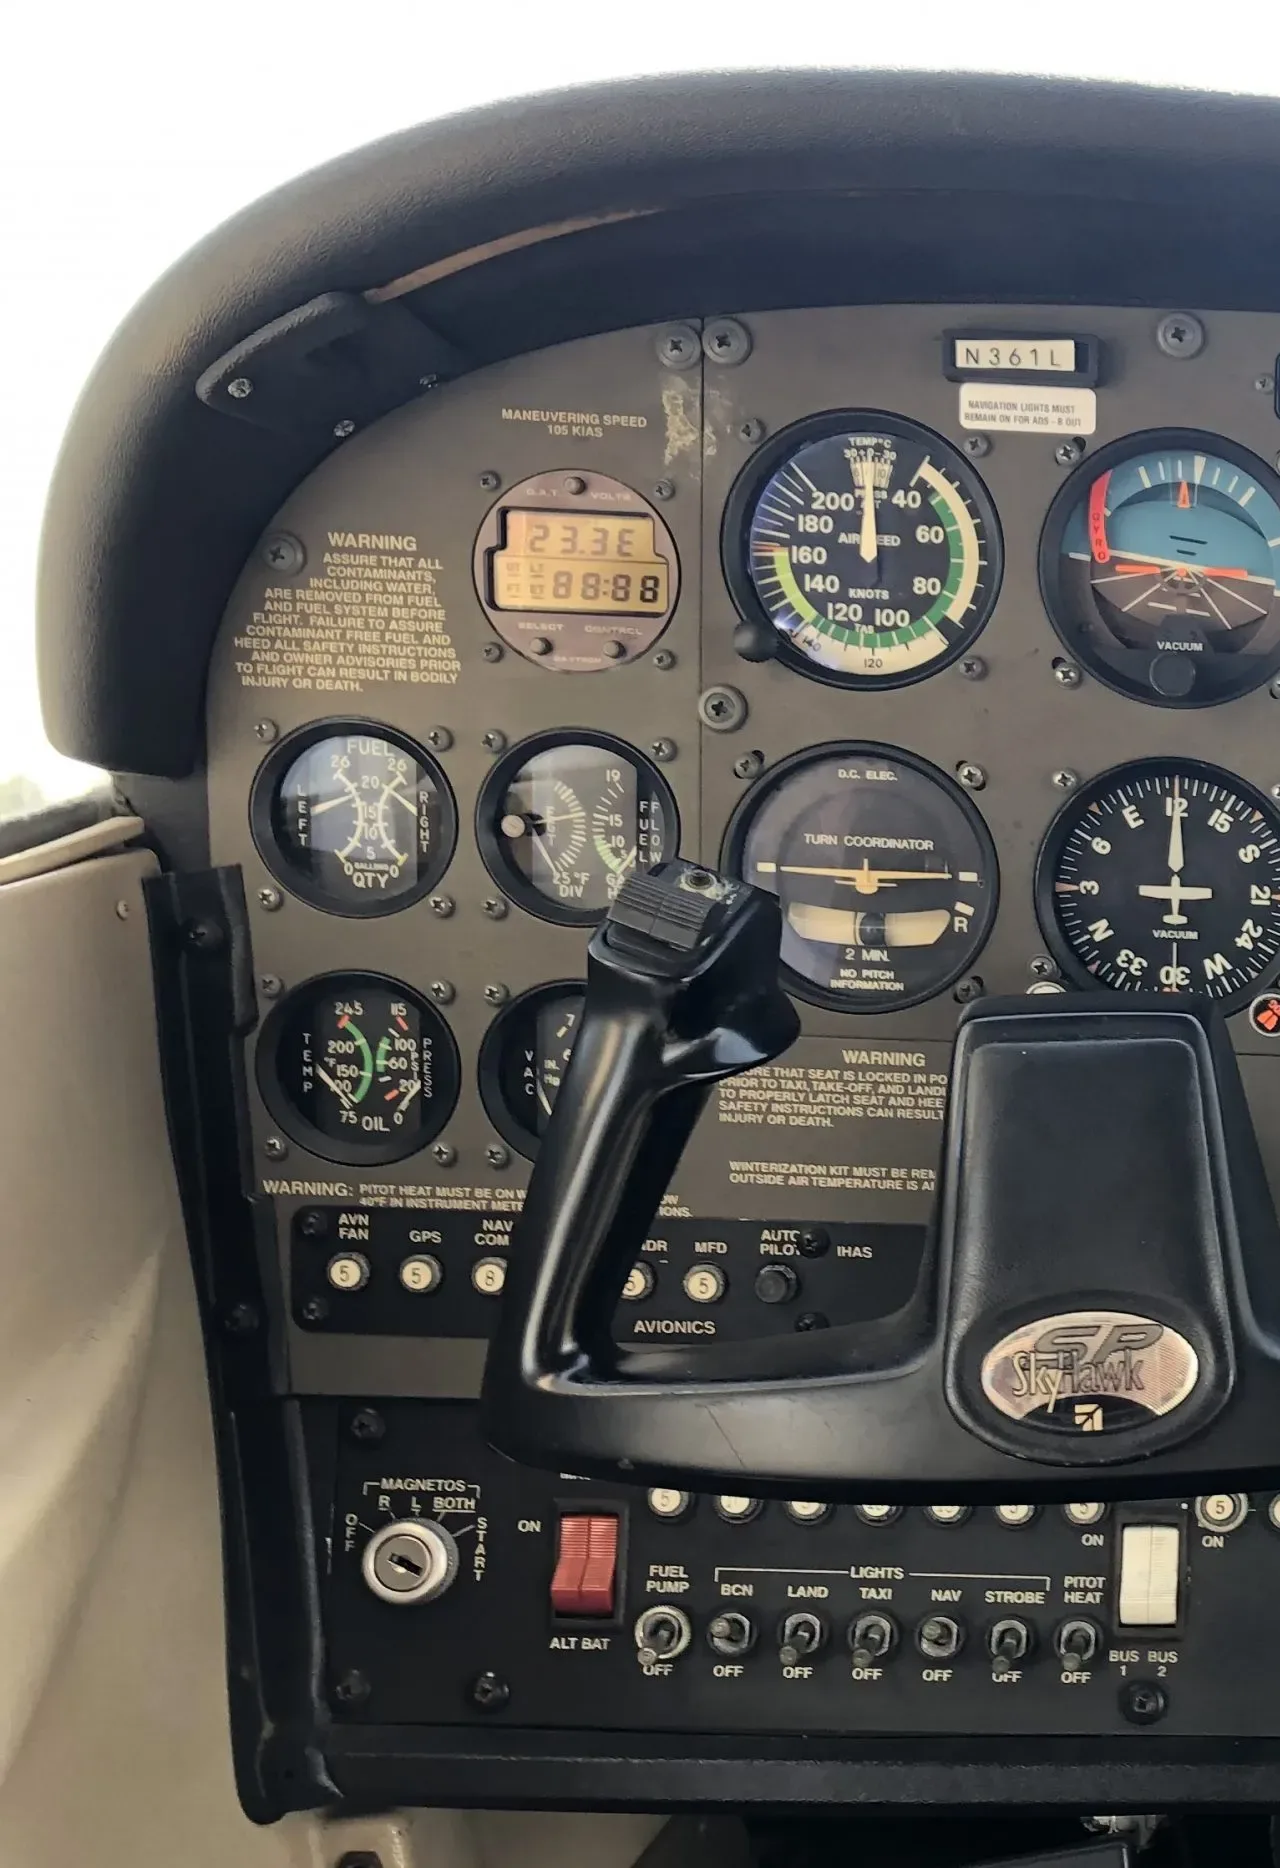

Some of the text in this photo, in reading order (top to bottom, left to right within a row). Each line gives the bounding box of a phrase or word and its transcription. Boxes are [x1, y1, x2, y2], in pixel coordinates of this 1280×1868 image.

[1020, 402, 1049, 414] LIGHTS
[1051, 404, 1075, 415] MUST
[501, 408, 647, 428] MANEUVERING SPEED
[547, 425, 604, 438] 105 KIAS
[811, 492, 854, 511] 200
[891, 490, 921, 509] 40
[798, 514, 833, 534] 180
[327, 531, 417, 552] WARNING
[915, 526, 944, 544] 60
[323, 552, 444, 570] ASSURE THAT ALL
[791, 546, 827, 565] 160
[309, 577, 384, 593] INCLUDING
[913, 577, 941, 596] 80
[848, 589, 889, 600] KNOTS
[1156, 641, 1203, 652] VACUUM
[346, 739, 395, 758] FUEL
[803, 833, 934, 851] TURN COORDINATOR
[352, 871, 389, 889] QTY
[955, 918, 969, 932] R
[845, 948, 856, 961] 2
[840, 969, 894, 981] NO PITCH
[830, 979, 904, 991] INFORMATION
[327, 1039, 355, 1053] 200
[842, 1049, 926, 1068] WARNING
[362, 1114, 390, 1132] OIL
[718, 1111, 765, 1125] INJURY
[769, 1114, 784, 1126] OR
[338, 1213, 369, 1228] AVN
[482, 1219, 513, 1233] NAV
[338, 1228, 369, 1242] FAN
[409, 1230, 441, 1245] GPS
[474, 1232, 510, 1247] COM
[694, 1241, 728, 1255] MFD
[837, 1245, 873, 1260] IHAS
[633, 1320, 716, 1336] AVIONICS
[380, 1478, 466, 1493] MAGNETOS
[433, 1497, 475, 1510] BOTH
[517, 1520, 541, 1533] ON
[1081, 1534, 1104, 1547] ON
[649, 1565, 689, 1580] FUEL
[850, 1566, 904, 1582] LIGHTS
[646, 1579, 689, 1594] PUMP
[1063, 1576, 1106, 1590] PITOT
[720, 1584, 753, 1598] BCN
[787, 1585, 829, 1600] LAND
[859, 1586, 893, 1601] TAXI
[931, 1588, 962, 1602] NAV
[985, 1590, 1045, 1605] STROBE
[1063, 1591, 1104, 1605] HEAT
[549, 1637, 611, 1651] ALT BAT
[712, 1665, 744, 1678] OFF
[782, 1666, 813, 1680] OFF
[852, 1667, 882, 1682] OFF
[922, 1669, 952, 1683] OFF
